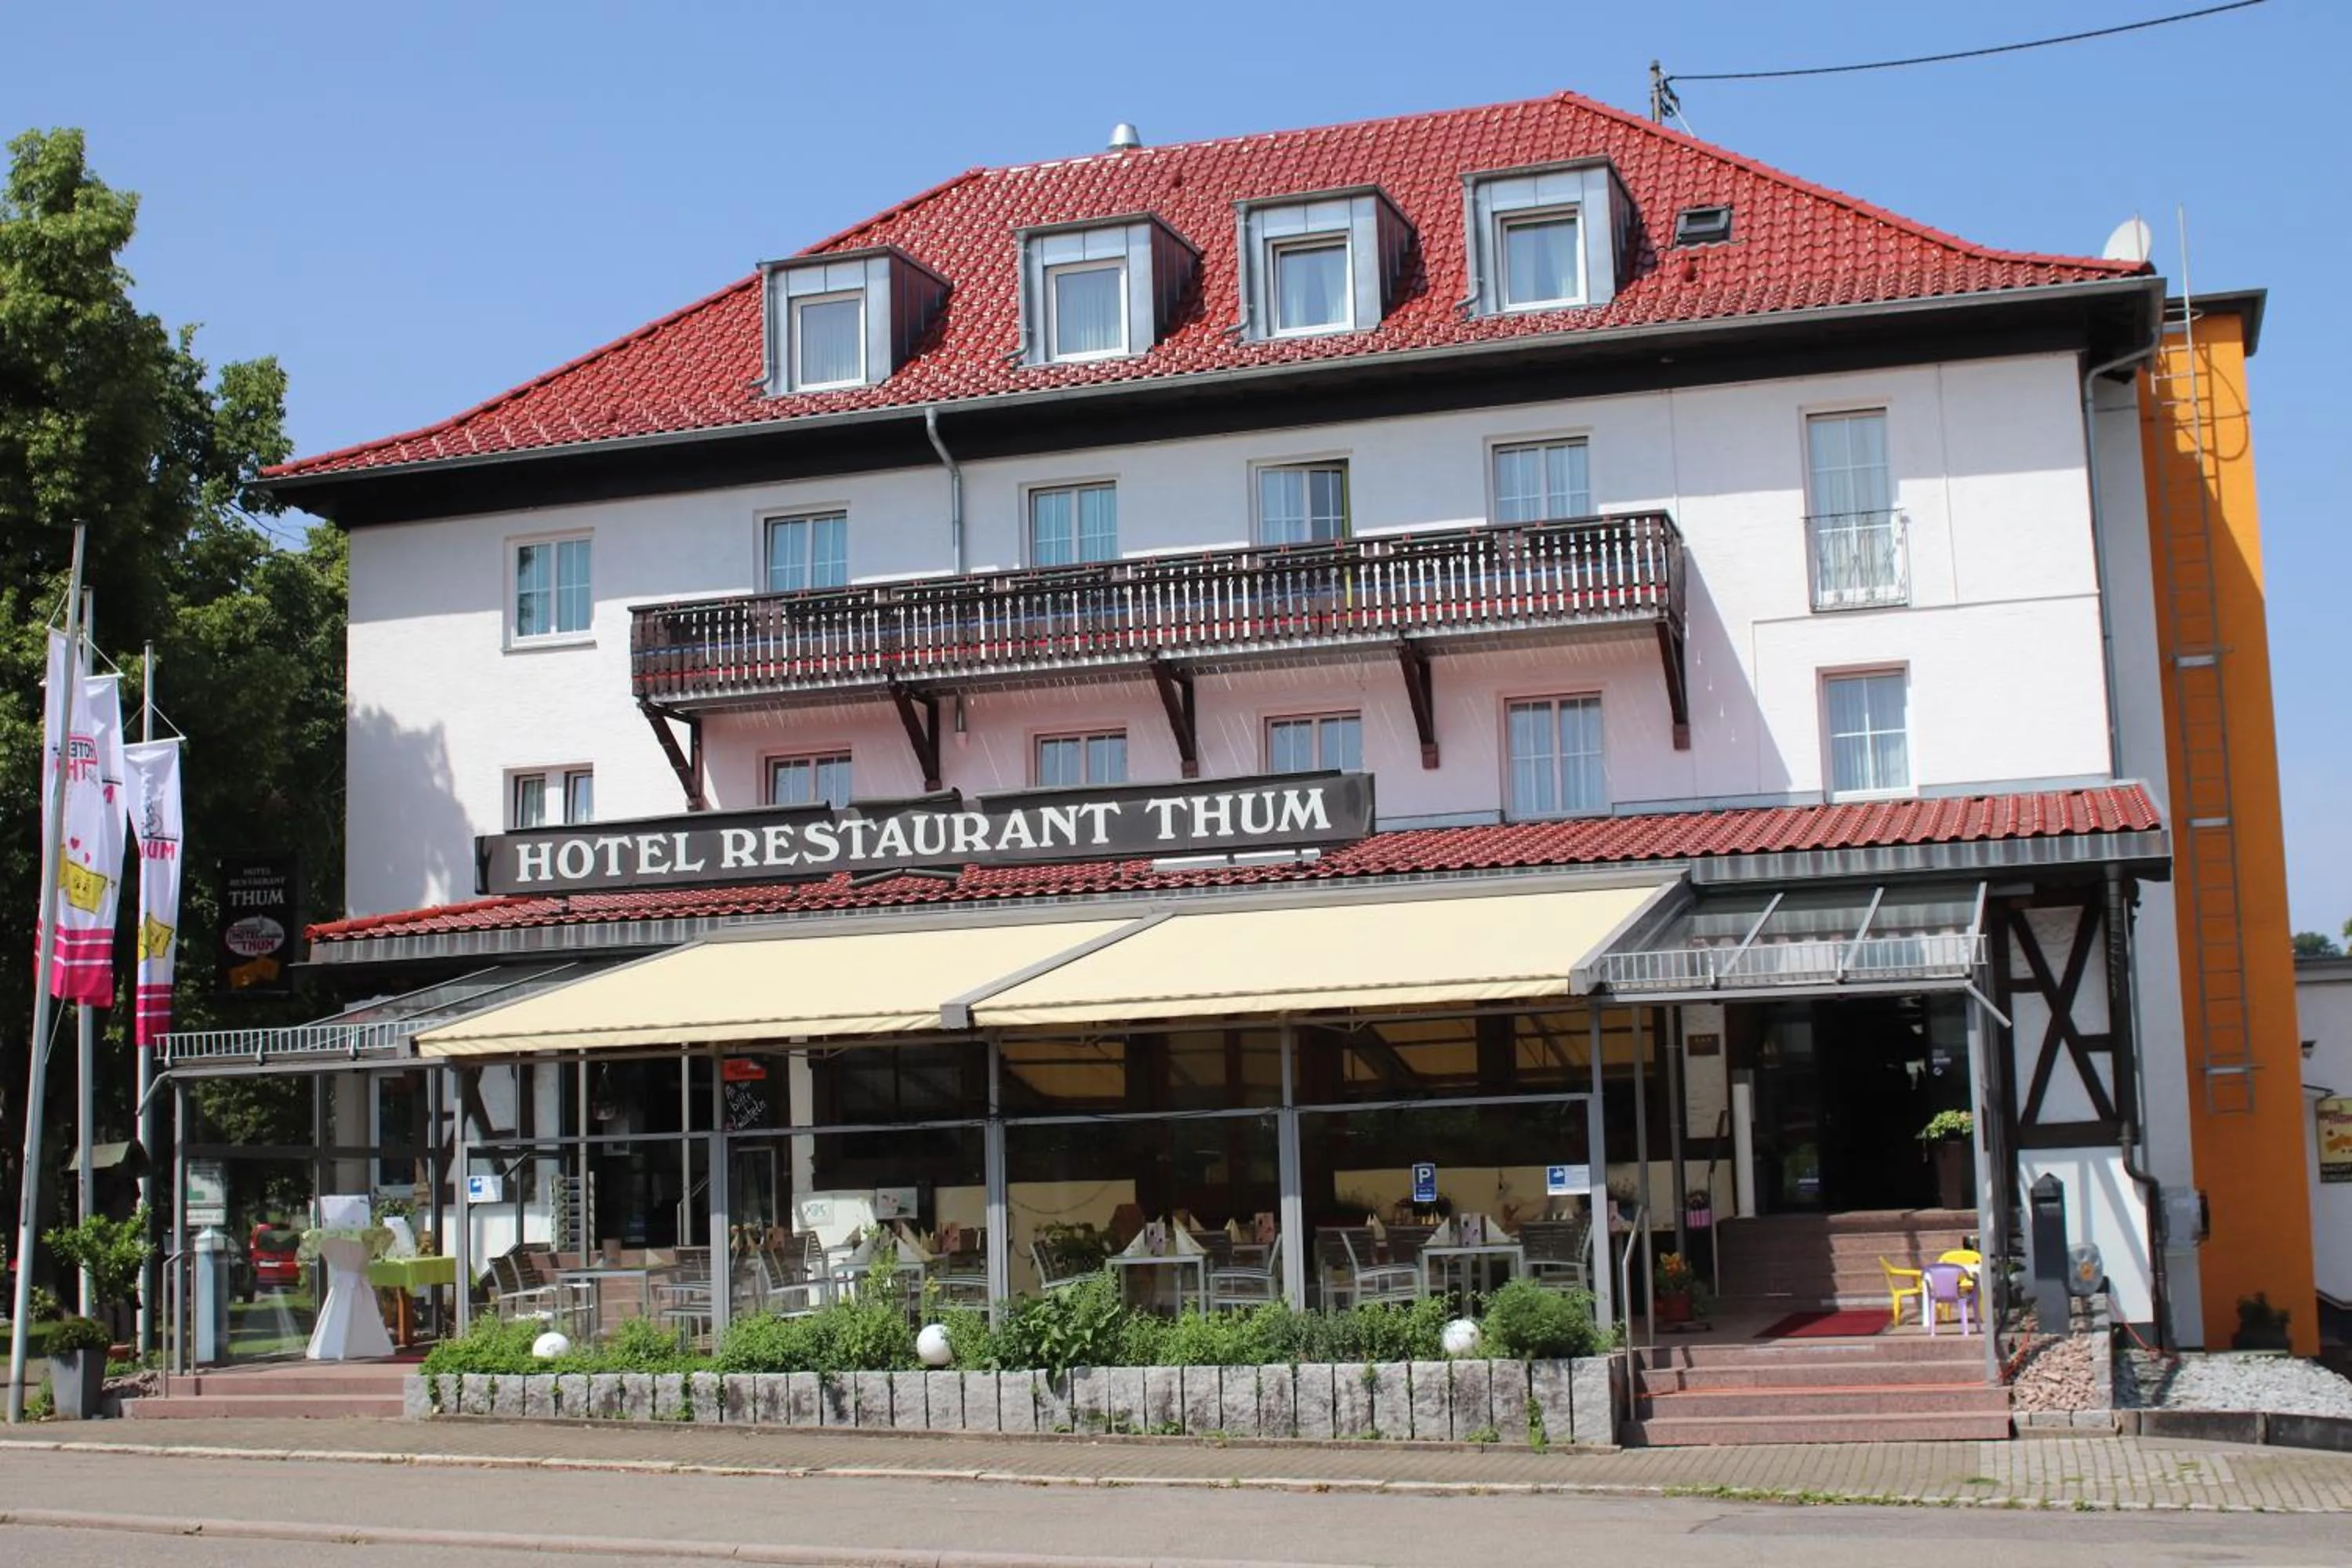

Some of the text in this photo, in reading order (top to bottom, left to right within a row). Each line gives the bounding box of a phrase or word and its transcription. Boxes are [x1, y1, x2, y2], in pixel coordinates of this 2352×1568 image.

[516, 788, 1332, 882] HOTEL RESTAURANT THUM
[228, 889, 285, 906] THUM
[241, 938, 275, 951] THUM
[1418, 1167, 1431, 1184] P
